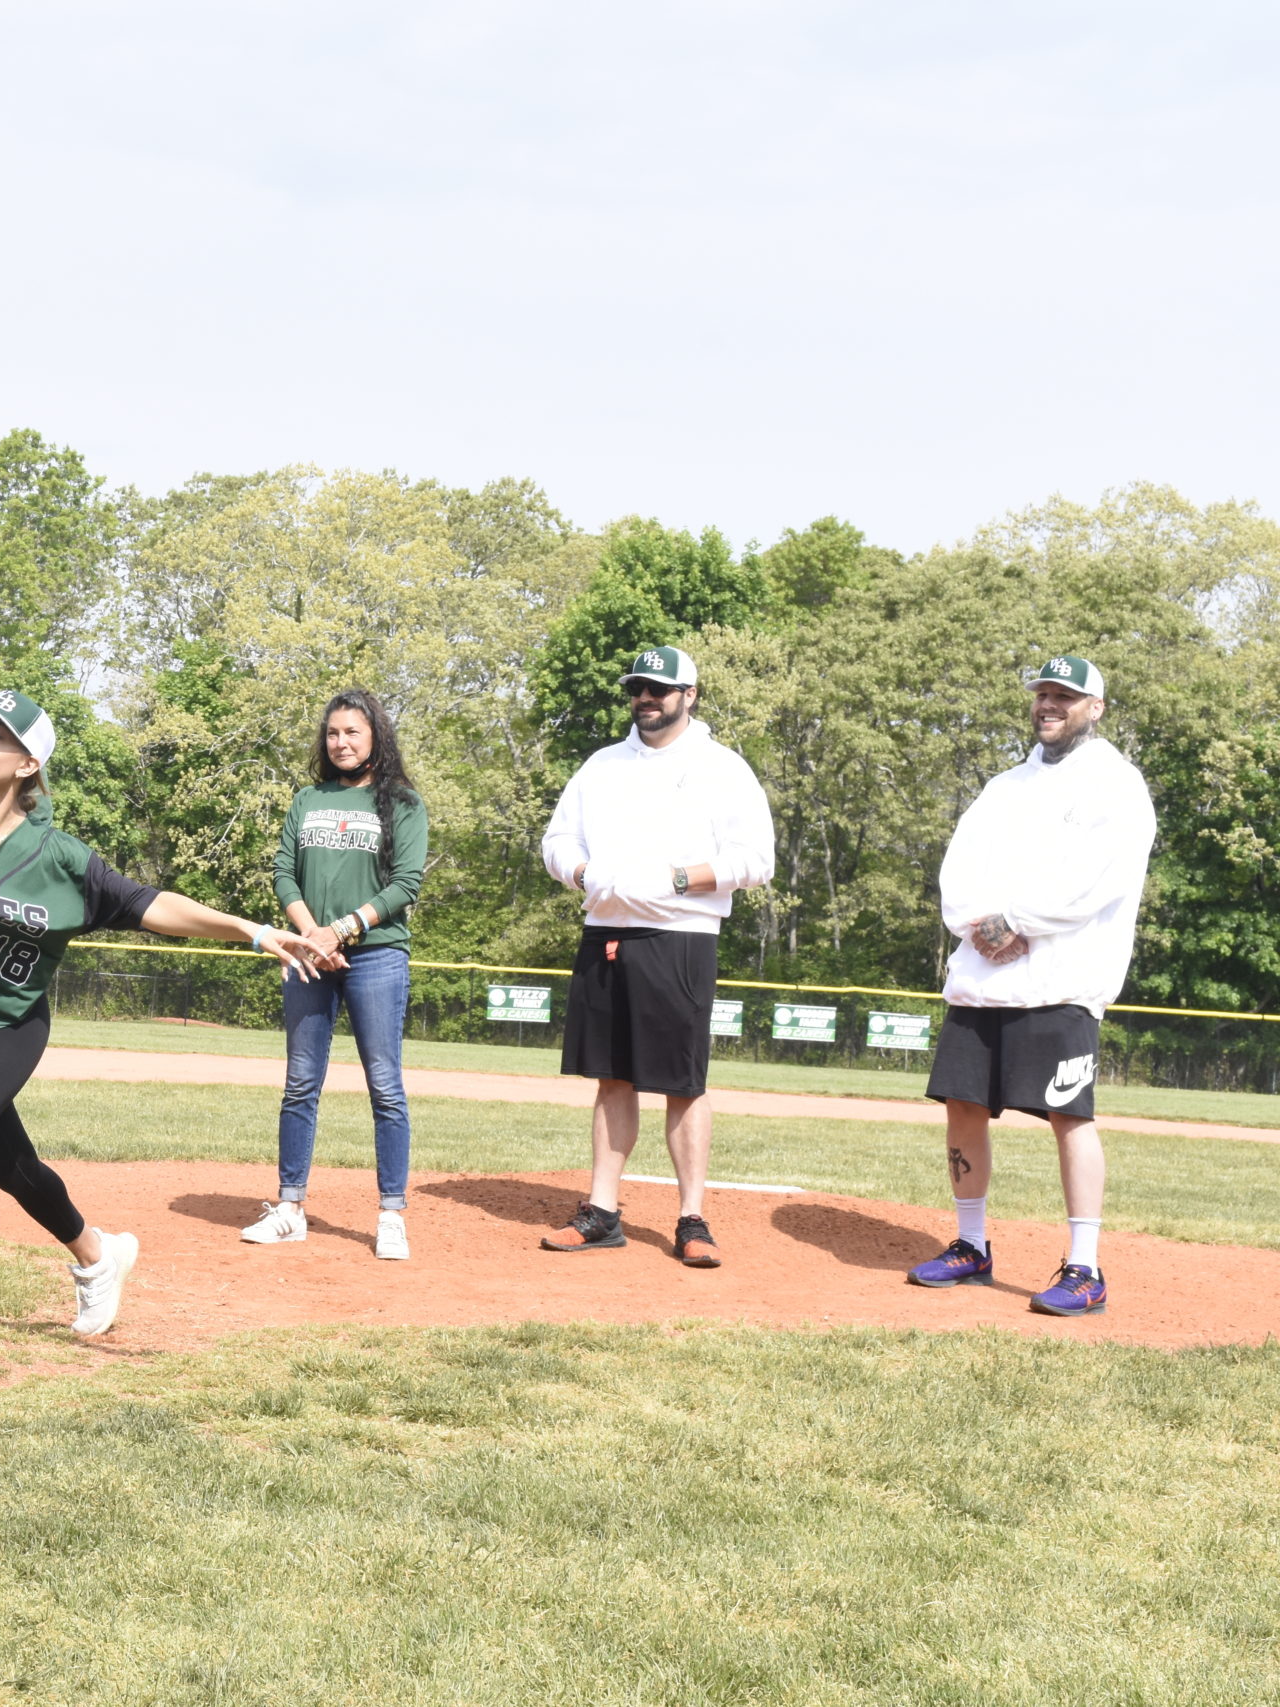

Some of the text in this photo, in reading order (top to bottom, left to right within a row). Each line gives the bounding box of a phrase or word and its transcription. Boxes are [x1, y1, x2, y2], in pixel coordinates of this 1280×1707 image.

[644, 651, 665, 671] WHB
[1050, 657, 1072, 677] WHB
[299, 828, 379, 854] BASEBALL
[508, 988, 549, 1001] RIZZO
[490, 1008, 548, 1020] GO CANES!!
[710, 1022, 740, 1033] NES!!
[775, 1027, 793, 1037] GO
